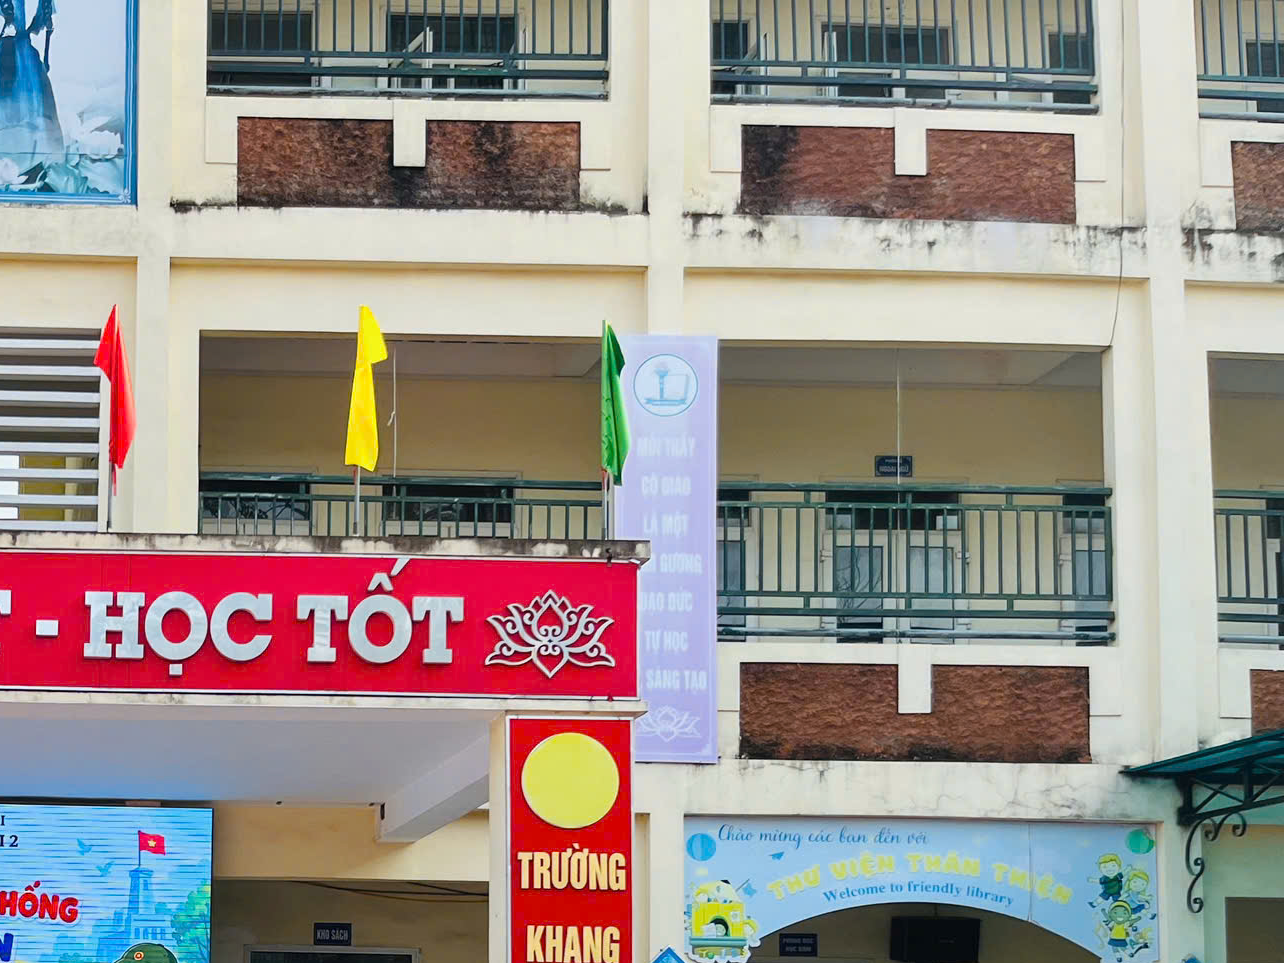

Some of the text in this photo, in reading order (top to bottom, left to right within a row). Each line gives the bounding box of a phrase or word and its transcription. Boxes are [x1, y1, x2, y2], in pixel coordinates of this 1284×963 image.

[83, 590, 273, 676] HỌC
[296, 557, 465, 665] TỐT
[663, 630, 688, 652] HỌC
[684, 669, 707, 694] TẠO
[9, 835, 18, 848] 2
[718, 824, 753, 842] Chào
[808, 829, 834, 843] các
[873, 827, 901, 844] đến
[517, 843, 626, 891] TRƯỜNG
[768, 851, 1073, 904] THƯ VIỆN THÂN THIỆN
[823, 881, 1014, 908] Welcome to friendly library
[316, 929, 330, 940] KHO
